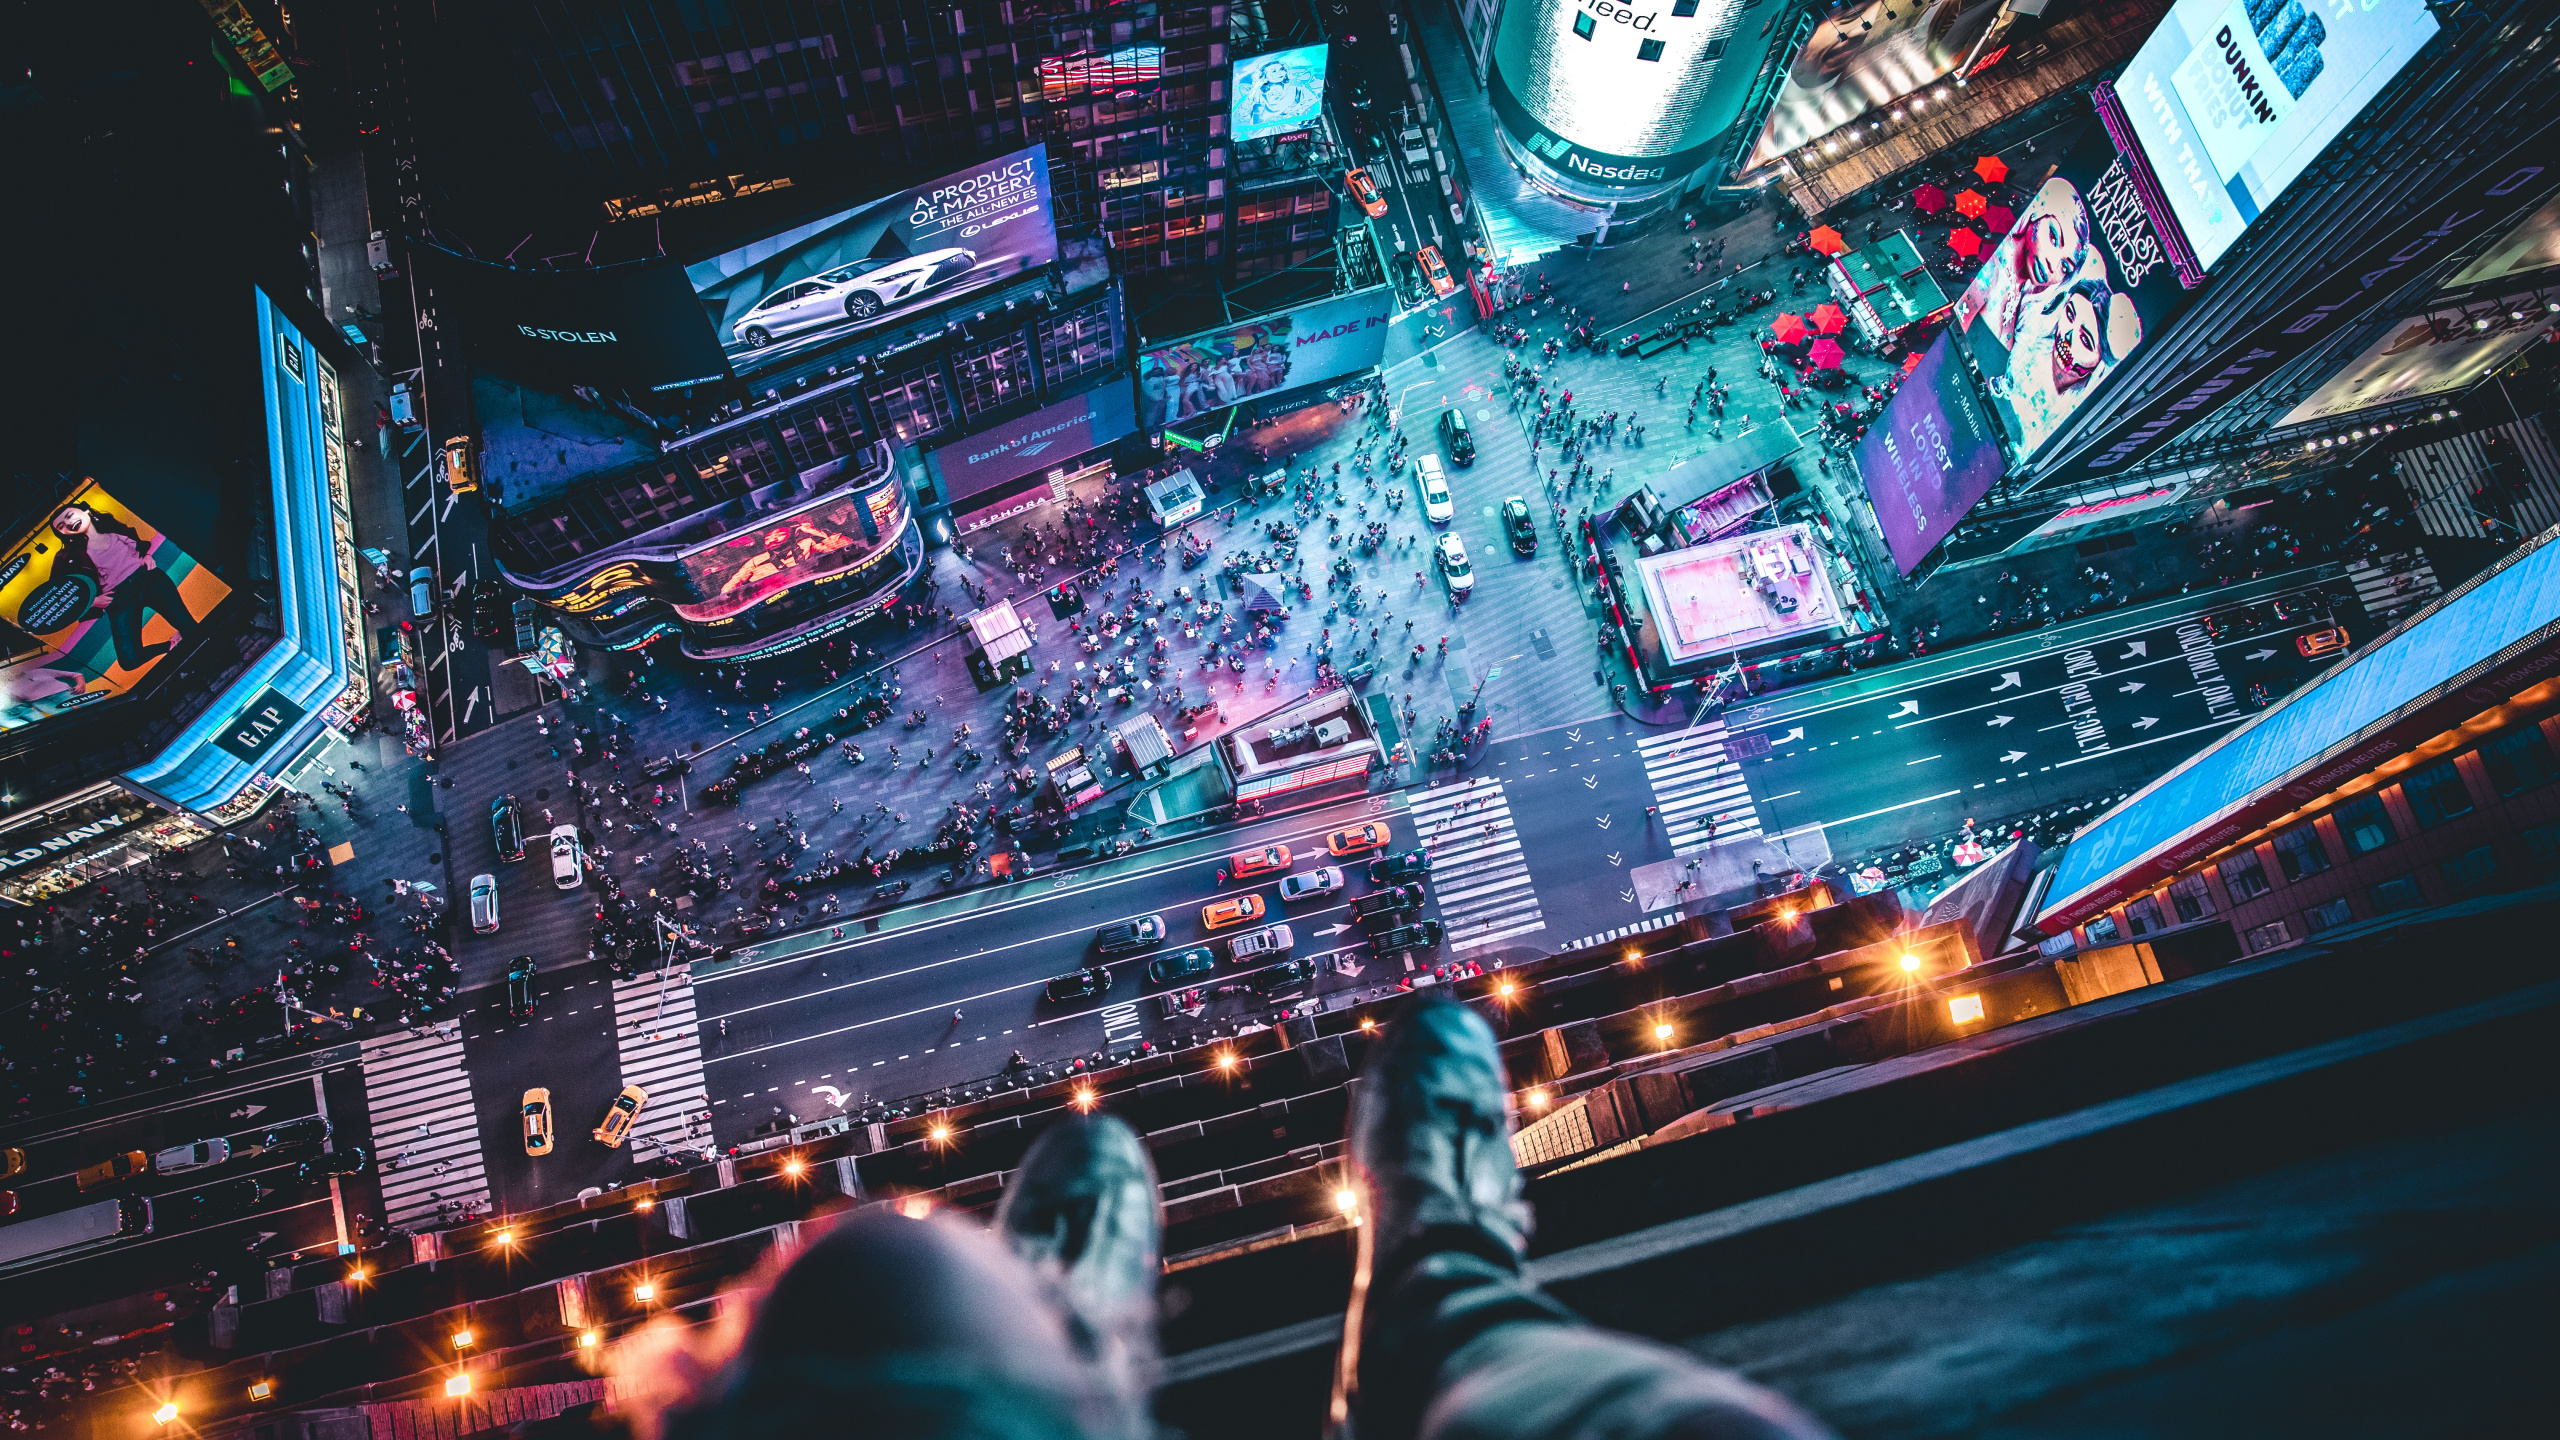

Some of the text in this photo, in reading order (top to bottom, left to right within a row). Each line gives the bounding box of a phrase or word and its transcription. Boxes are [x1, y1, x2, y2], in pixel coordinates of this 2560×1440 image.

[2201, 42, 2253, 130] DONUT
[2216, 25, 2277, 123] DUNKIN'
[2143, 72, 2183, 145] WITH
[2188, 60, 2228, 129] FRIES
[915, 157, 1034, 210] A PRODUCT
[1568, 153, 1665, 181] Nasdaq
[910, 171, 1035, 225] OF MASTERY
[940, 187, 1037, 228] THE ALL-NEW ES
[982, 205, 1040, 229] LEXUS
[2101, 159, 2165, 275] FANTASY
[2086, 177, 2145, 288] MAKERS
[517, 324, 618, 343] IS STOLEN
[1296, 312, 1388, 348] MADE IN
[2088, 417, 2181, 468] CALL
[2165, 347, 2278, 412] DUTY
[2281, 210, 2485, 335] BLACK
[1269, 399, 1310, 414] CITIZEN
[968, 410, 1098, 465] Bank of America
[1910, 421, 1943, 490] LOVED
[1922, 412, 1953, 472] MOST
[1884, 431, 1928, 536] WIRELESS.
[1909, 457, 1923, 482] IN
[969, 497, 1046, 530] SEPHORA
[2, 557, 26, 580] NAVY
[814, 572, 845, 586] NOW
[846, 567, 861, 577] ON
[25, 580, 74, 625] ROCKSTAR WITH
[32, 584, 80, 629] SECRET-SLIM
[46, 595, 80, 627] POCKETS
[643, 622, 667, 640] actor
[2176, 623, 2215, 653] ONLY
[2063, 649, 2102, 679] ONLY
[2187, 651, 2226, 685] ONLY
[2493, 653, 2559, 688] THOMSON
[62, 696, 79, 708] OLD
[2202, 684, 2241, 720] ONLY
[237, 706, 283, 748] GAP
[2308, 739, 2398, 788] THOMSON REUTERS
[40, 814, 124, 851] NAVY
[2173, 824, 2241, 862] THOMSON REUTERS
[64, 858, 89, 869] OLD
[1100, 1004, 1143, 1043] ONLY
